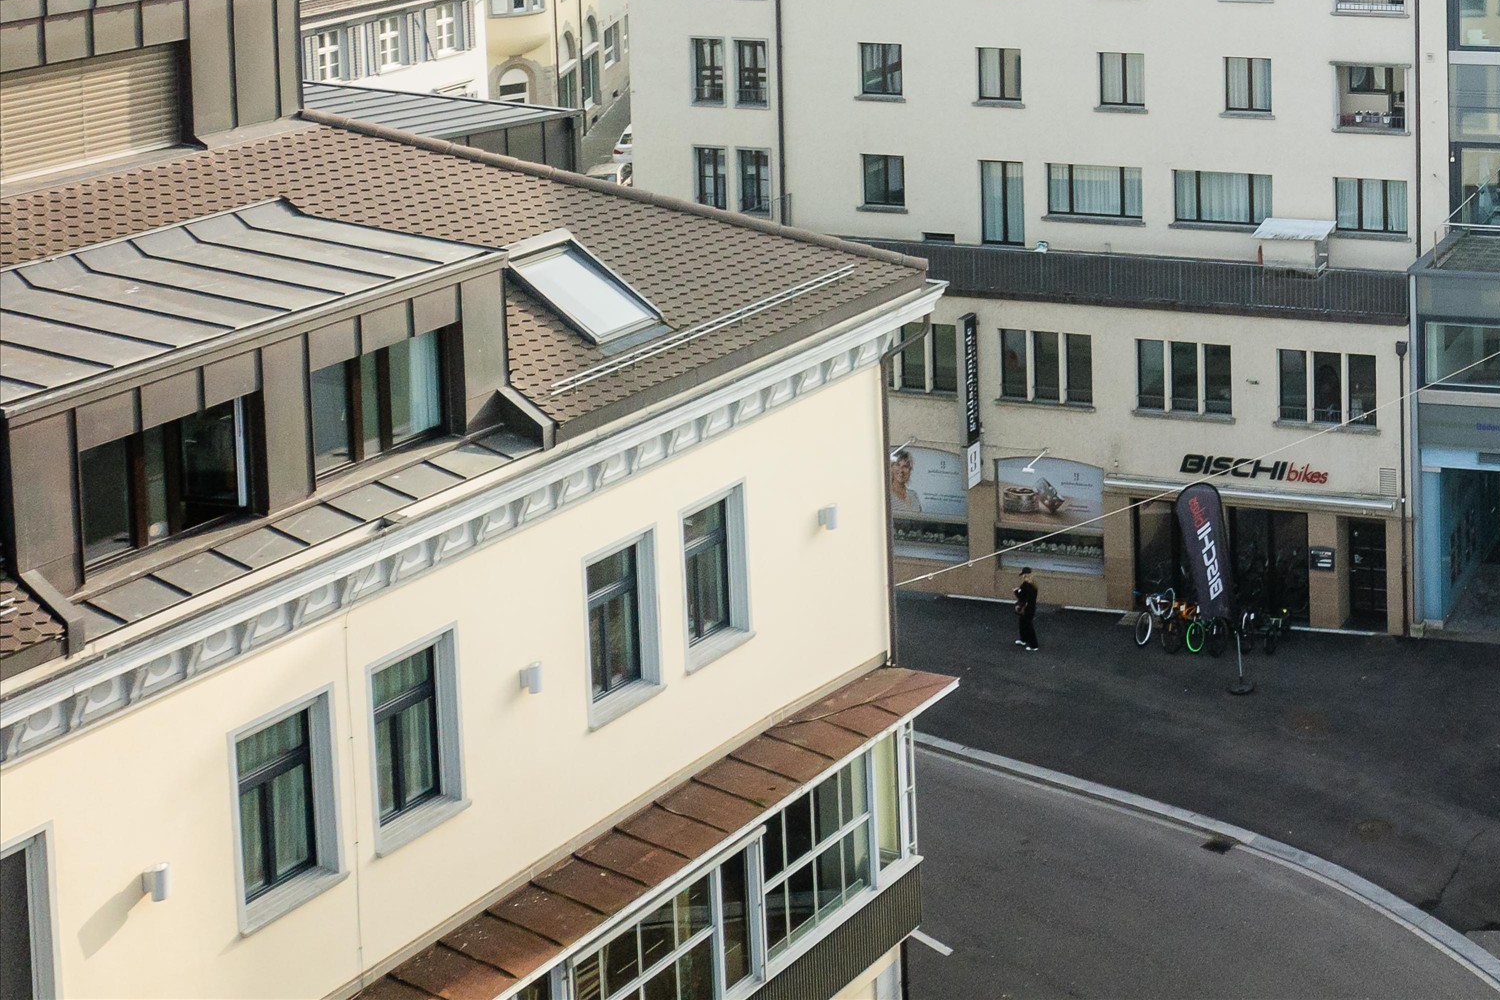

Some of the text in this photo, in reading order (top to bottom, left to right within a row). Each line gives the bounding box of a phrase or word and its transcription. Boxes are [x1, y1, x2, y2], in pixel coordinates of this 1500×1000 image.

[965, 327, 977, 433] goldschmiede
[1179, 453, 1329, 484] BISCHI bikes
